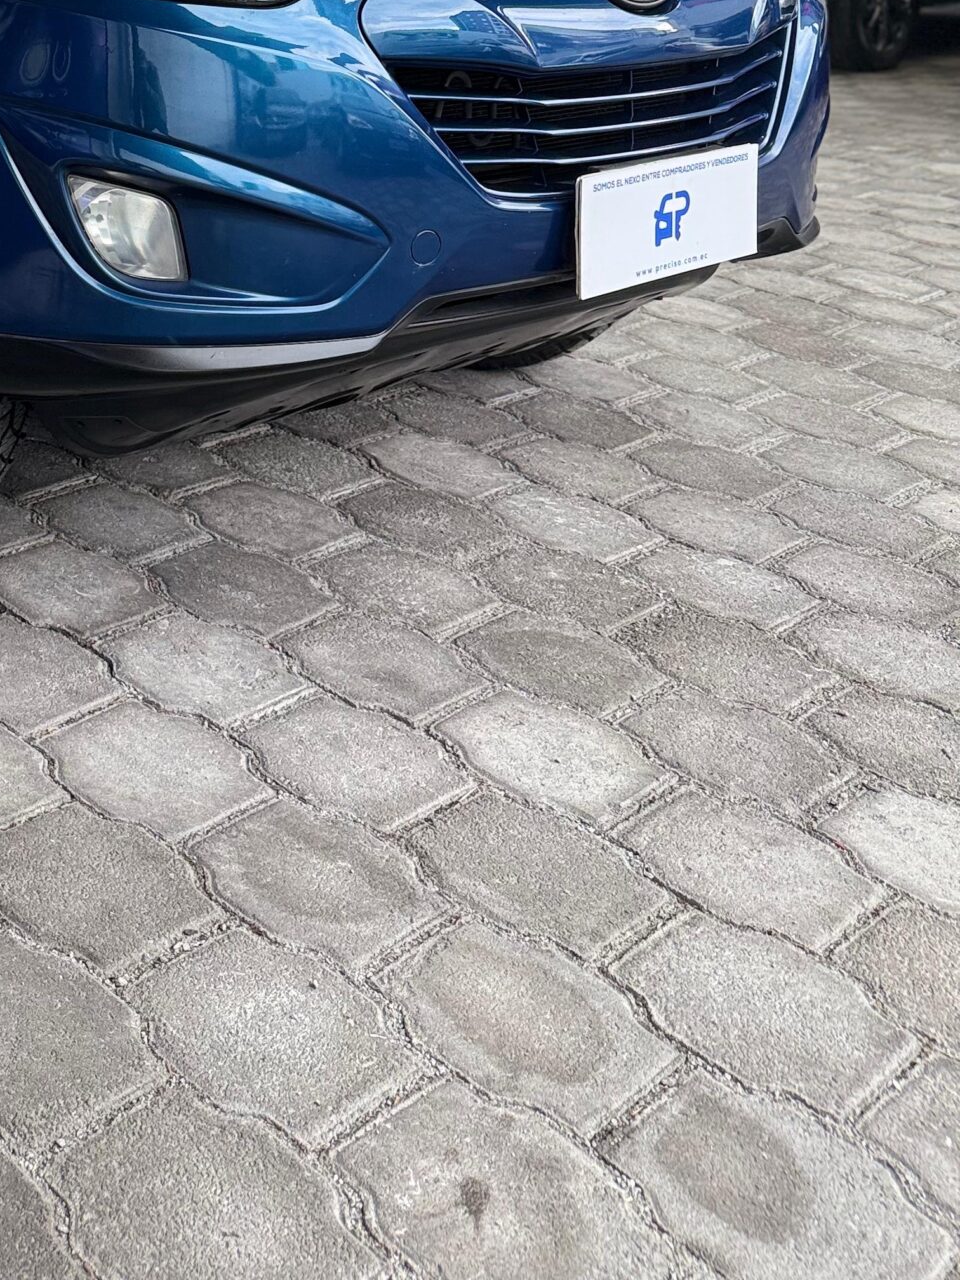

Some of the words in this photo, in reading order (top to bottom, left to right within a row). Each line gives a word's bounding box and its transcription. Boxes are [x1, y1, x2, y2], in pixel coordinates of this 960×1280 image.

[593, 180, 616, 193] SOMOS
[616, 178, 624, 188] EL
[624, 175, 641, 187] NEXO
[641, 170, 661, 183] ENTRE
[661, 161, 706, 178] COMPRADORES
[711, 153, 749, 167] VENDEDORES
